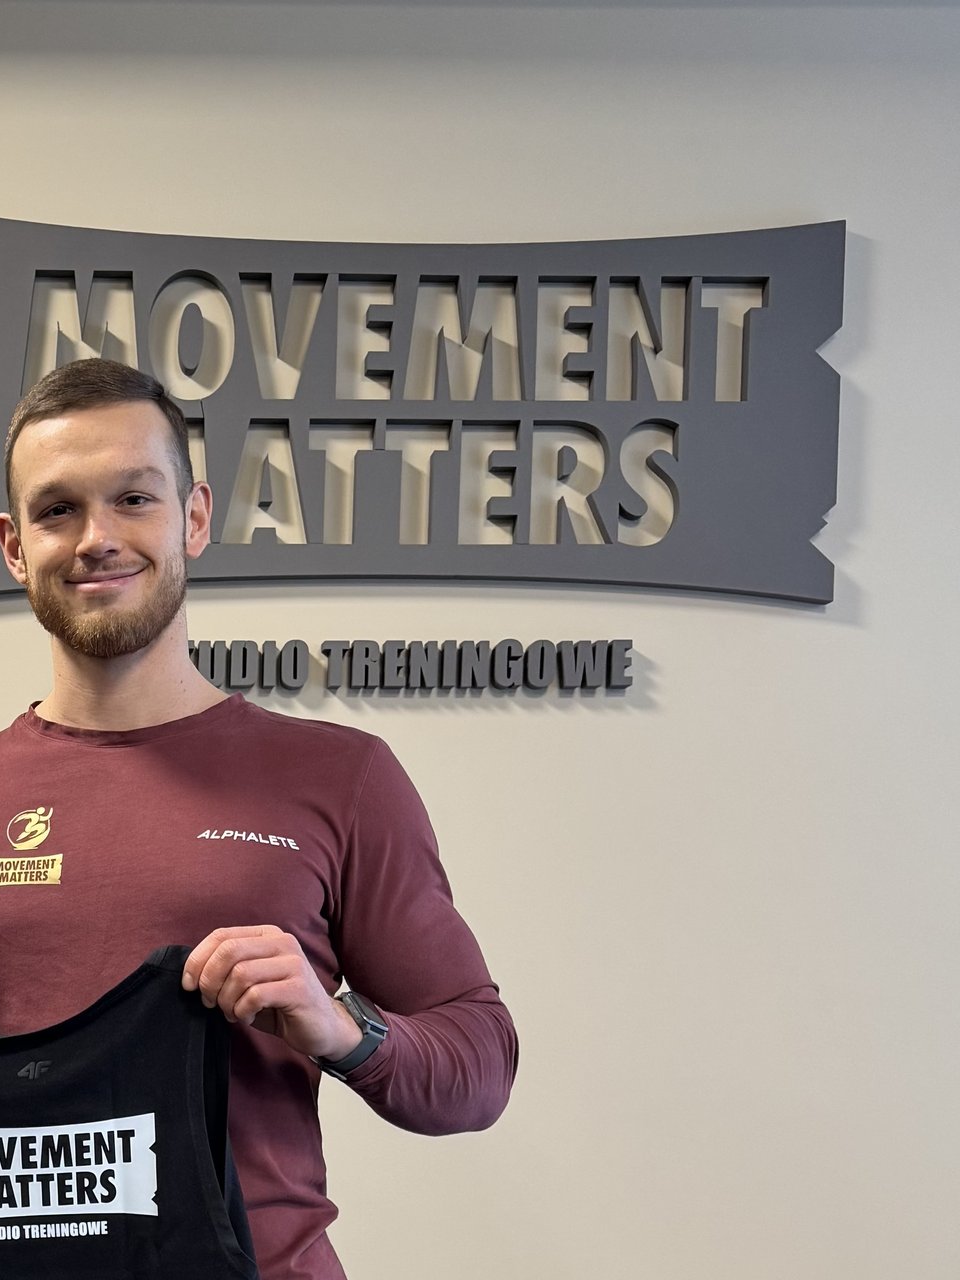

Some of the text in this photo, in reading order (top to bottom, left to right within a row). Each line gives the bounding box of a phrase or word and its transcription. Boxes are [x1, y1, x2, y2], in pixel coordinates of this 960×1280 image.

[23, 270, 770, 403] MOVEMENT
[186, 417, 680, 546] ATTERS
[188, 638, 634, 691] UDIO TRENINGOWE
[197, 829, 300, 850] ALPHALETE
[17, 1060, 52, 1080] 4F
[23, 1220, 109, 1240] TRENINGOWE
